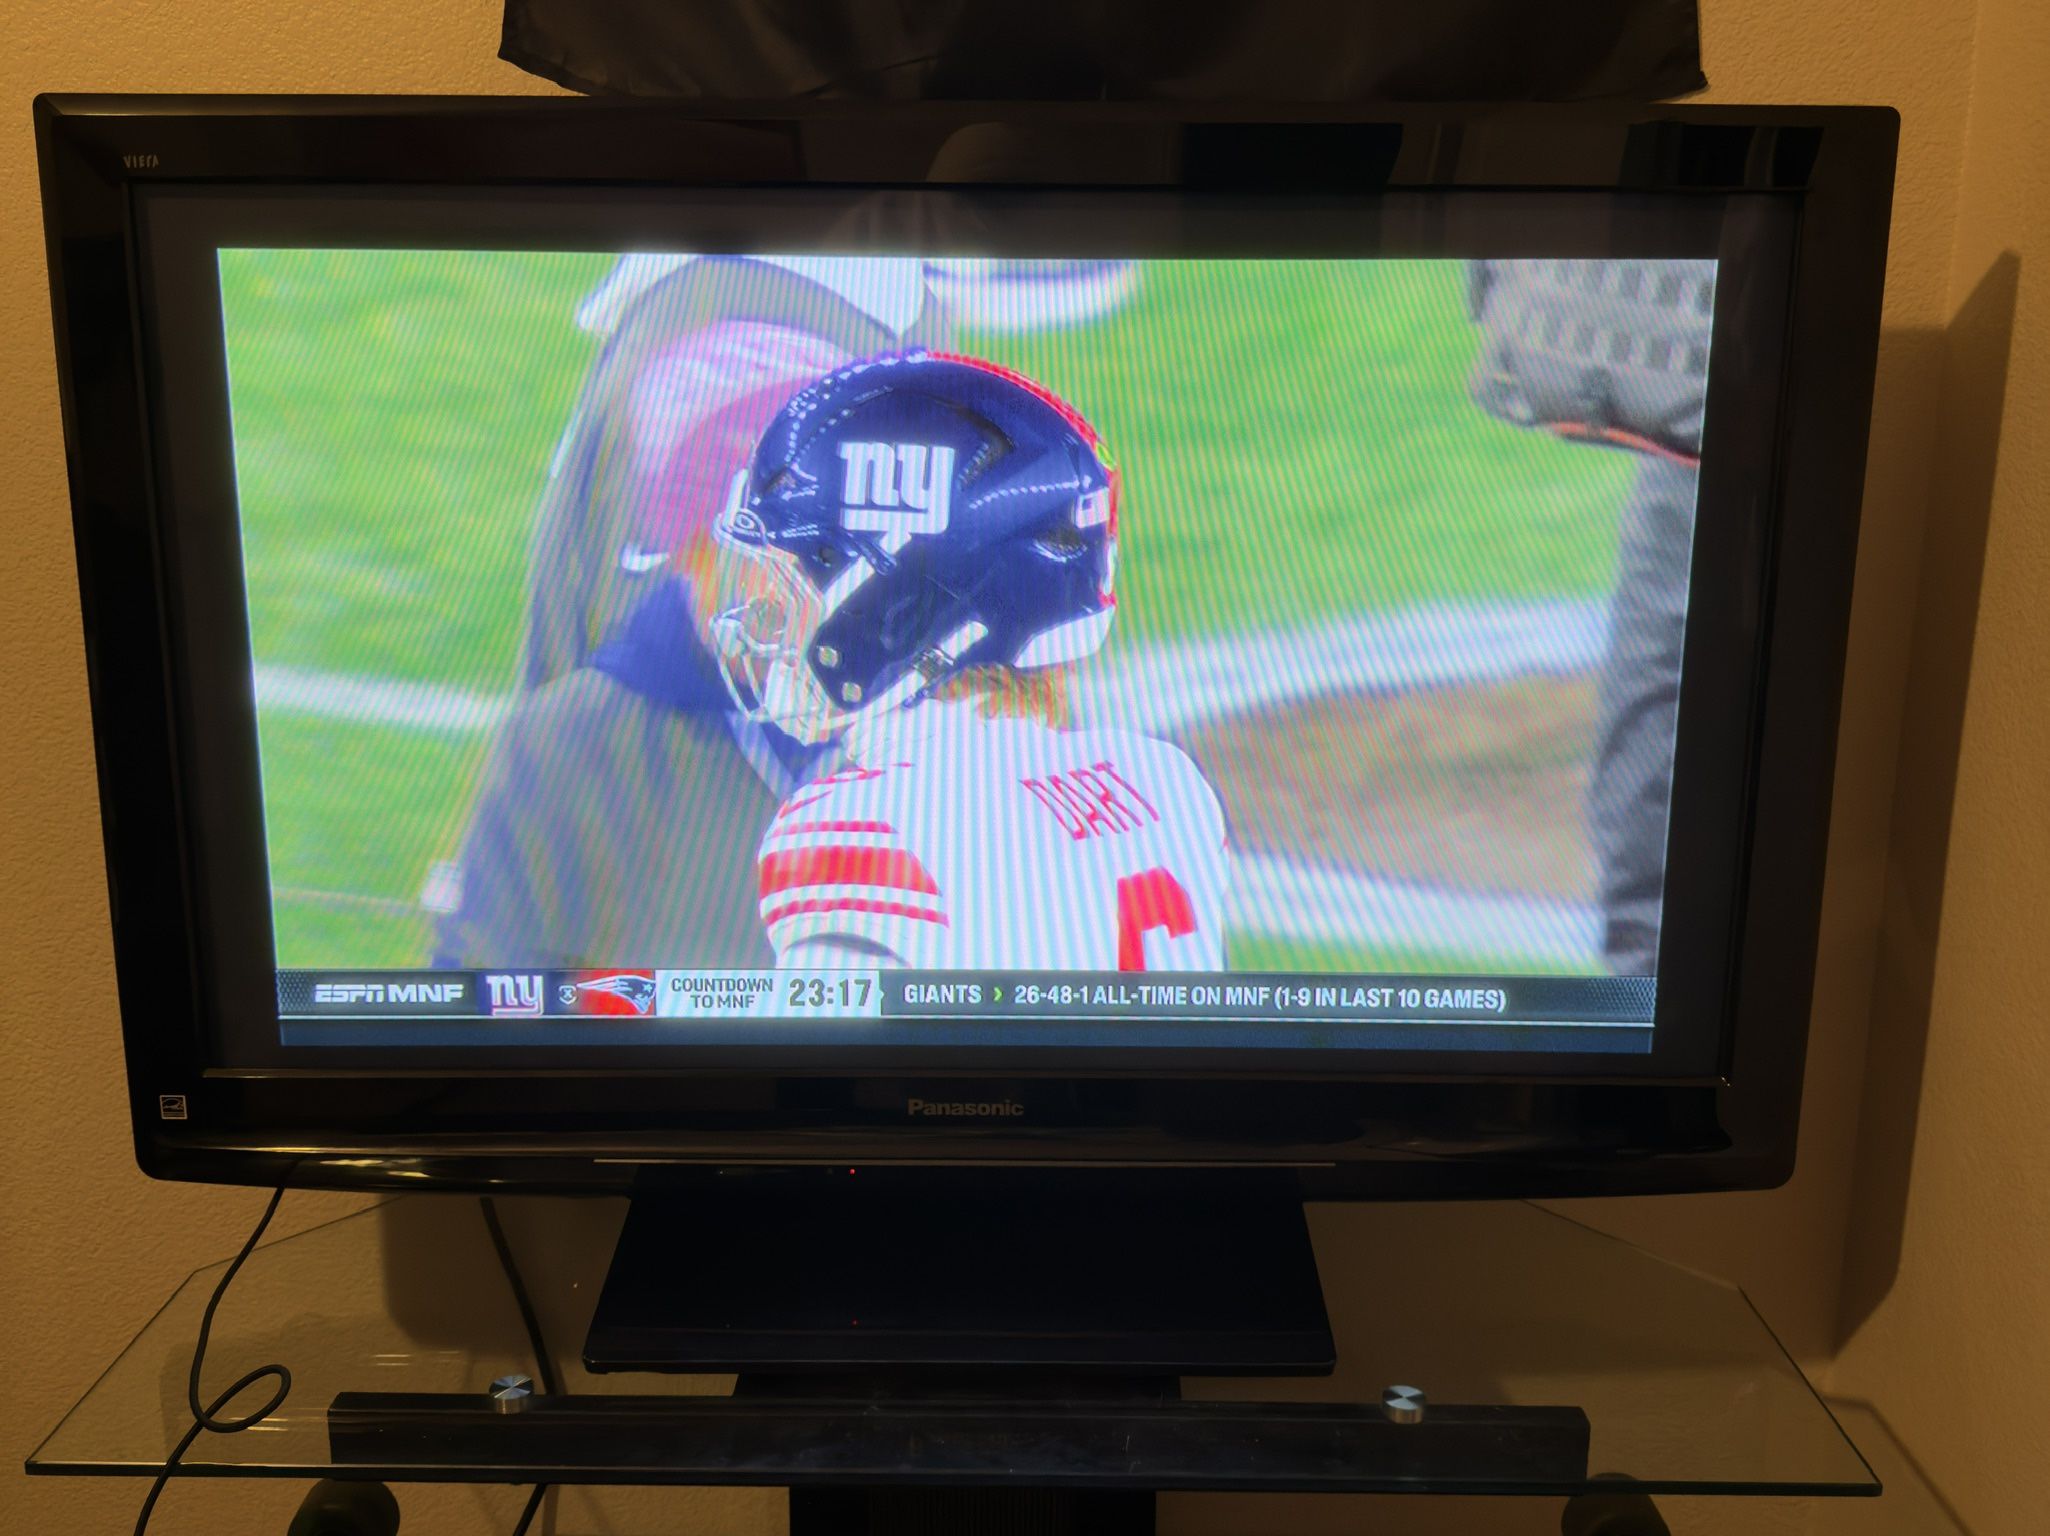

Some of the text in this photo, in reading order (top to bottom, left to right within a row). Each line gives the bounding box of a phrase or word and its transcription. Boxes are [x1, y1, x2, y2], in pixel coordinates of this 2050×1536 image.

[1018, 760, 1160, 842] DART
[314, 983, 465, 1003] ESPN MNF
[670, 977, 774, 993] COUNTDOWN
[788, 978, 873, 1009] 23:17
[690, 994, 756, 1009] TO MNF
[904, 984, 1507, 1013] GIANTS 26-48-1 ALL-TIME ON MNF (1-9 IN LAST 10 GAMES)
[907, 1098, 1025, 1117] Panasonic
